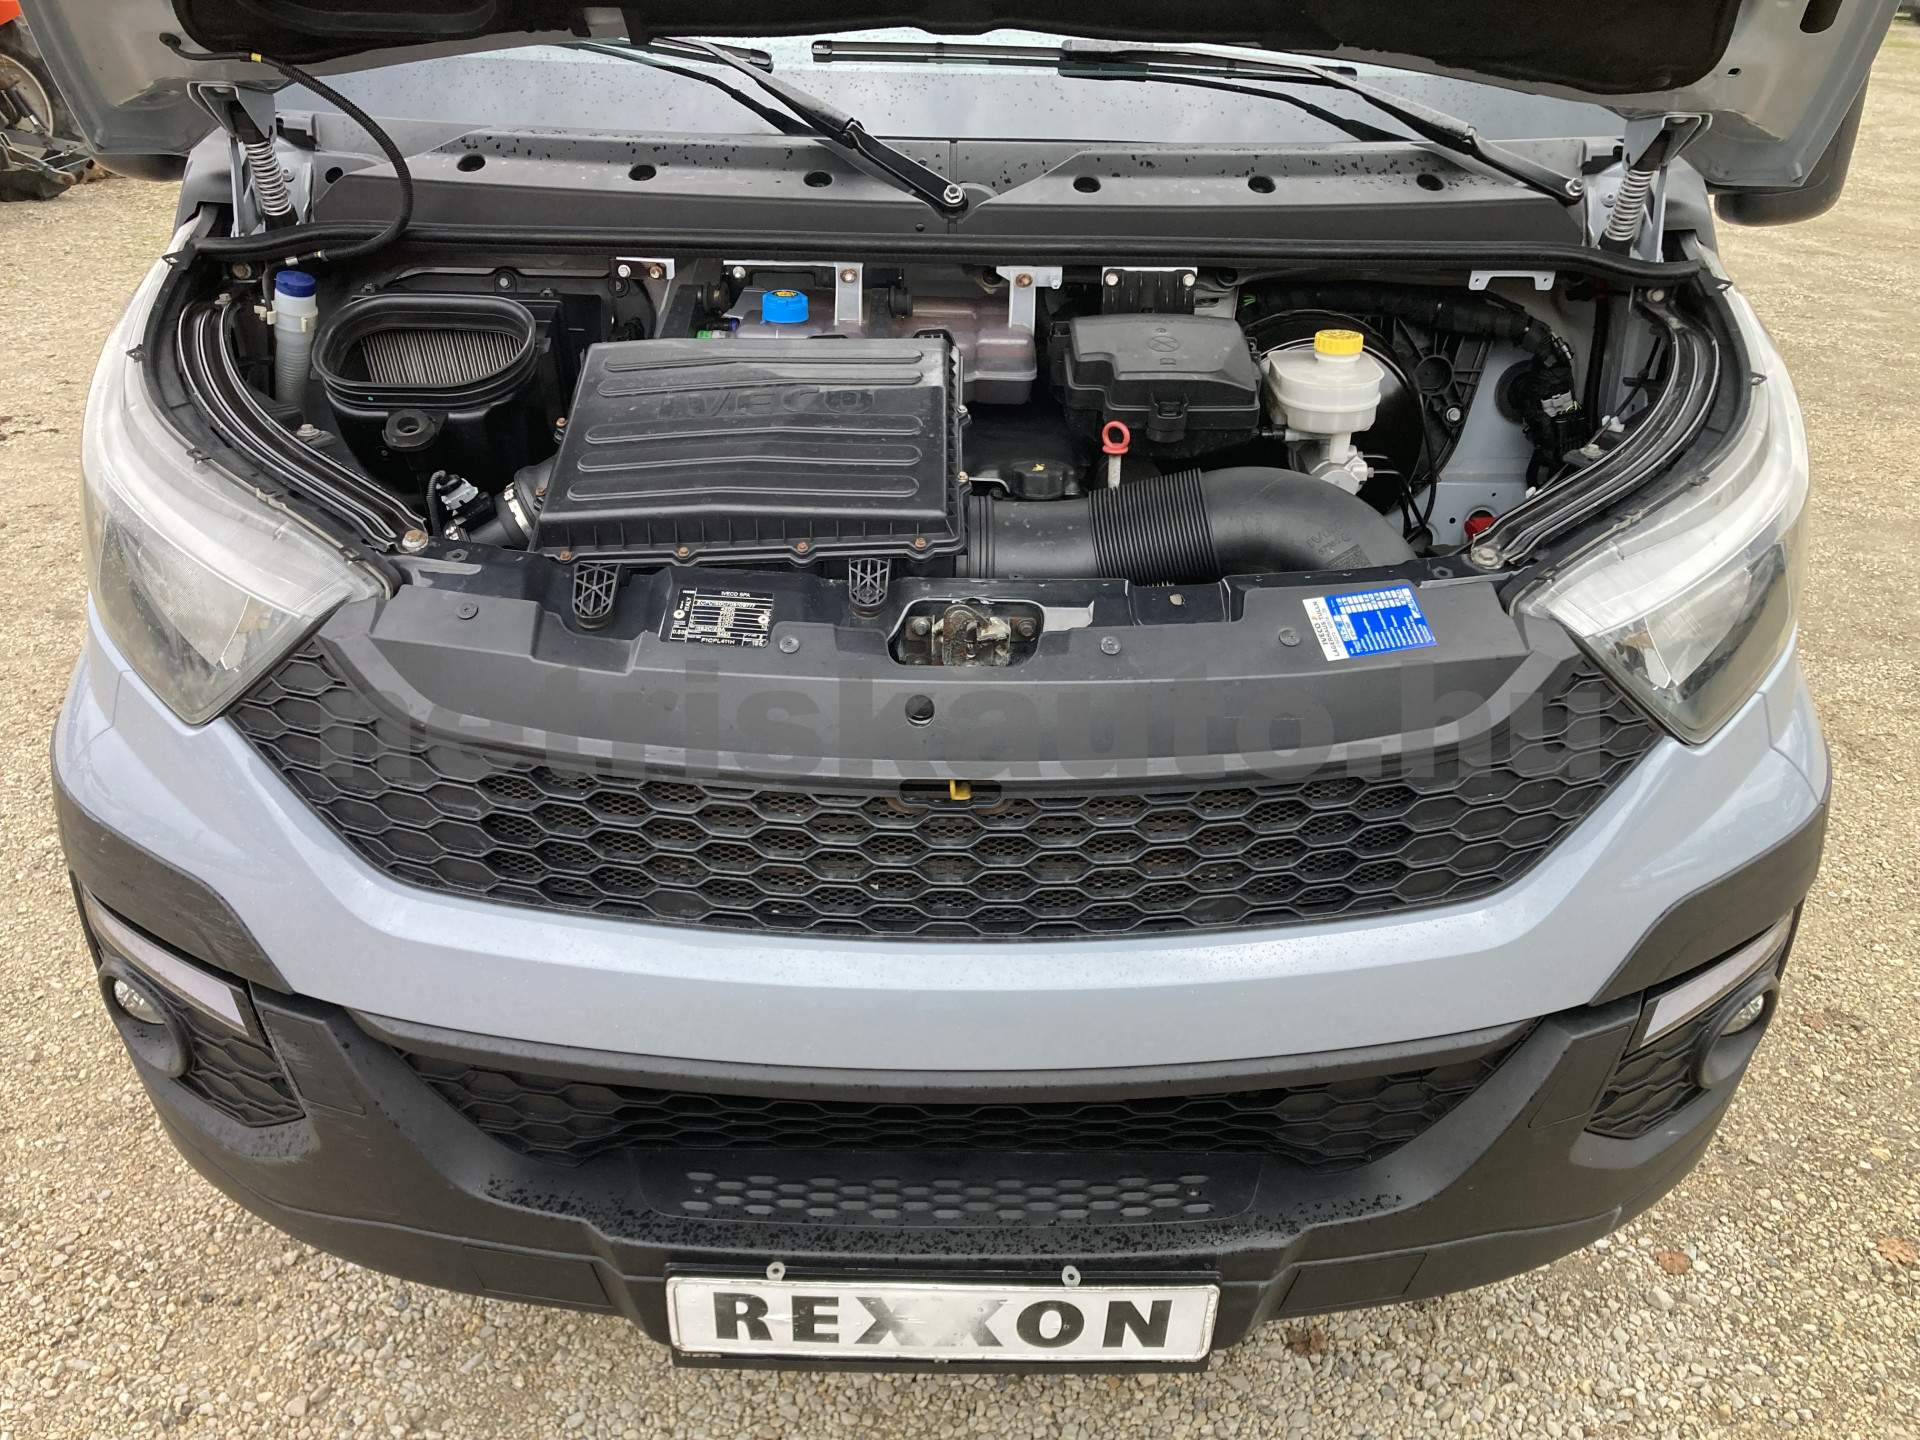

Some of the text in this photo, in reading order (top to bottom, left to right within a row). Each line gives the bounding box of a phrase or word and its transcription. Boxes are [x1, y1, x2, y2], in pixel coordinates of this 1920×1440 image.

[657, 386, 876, 419] IVECO
[1311, 600, 1324, 620] TULLN
[1313, 622, 1328, 645] IVECO
[1319, 620, 1340, 657] LAGERHAUS
[712, 1291, 1174, 1349] REXXON
